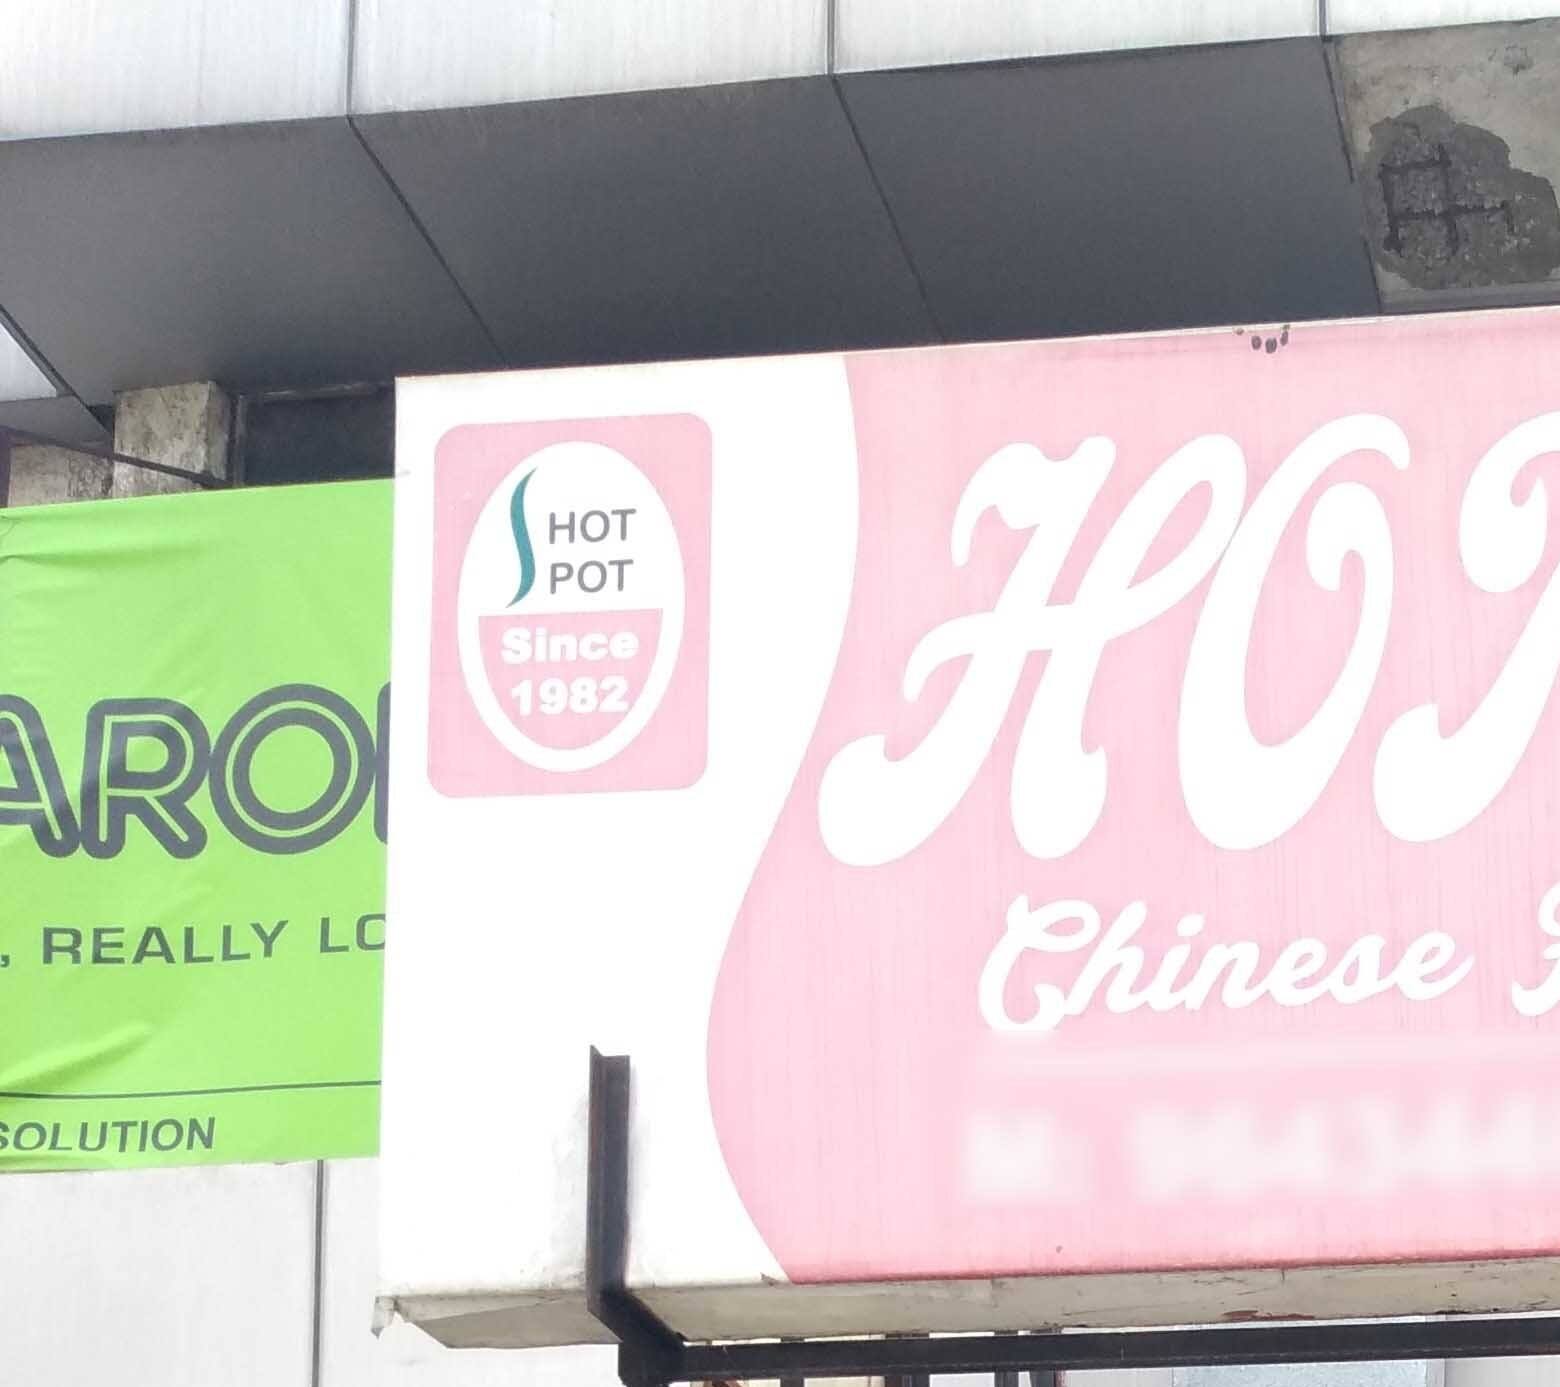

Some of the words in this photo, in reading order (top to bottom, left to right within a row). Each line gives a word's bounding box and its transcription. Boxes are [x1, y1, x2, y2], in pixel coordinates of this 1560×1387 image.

[548, 509, 637, 546] HOT
[549, 558, 635, 595] POT
[500, 626, 641, 664] Since
[511, 677, 630, 718] 1982
[41, 918, 291, 966] REALLY
[977, 893, 1475, 1034] Chinese
